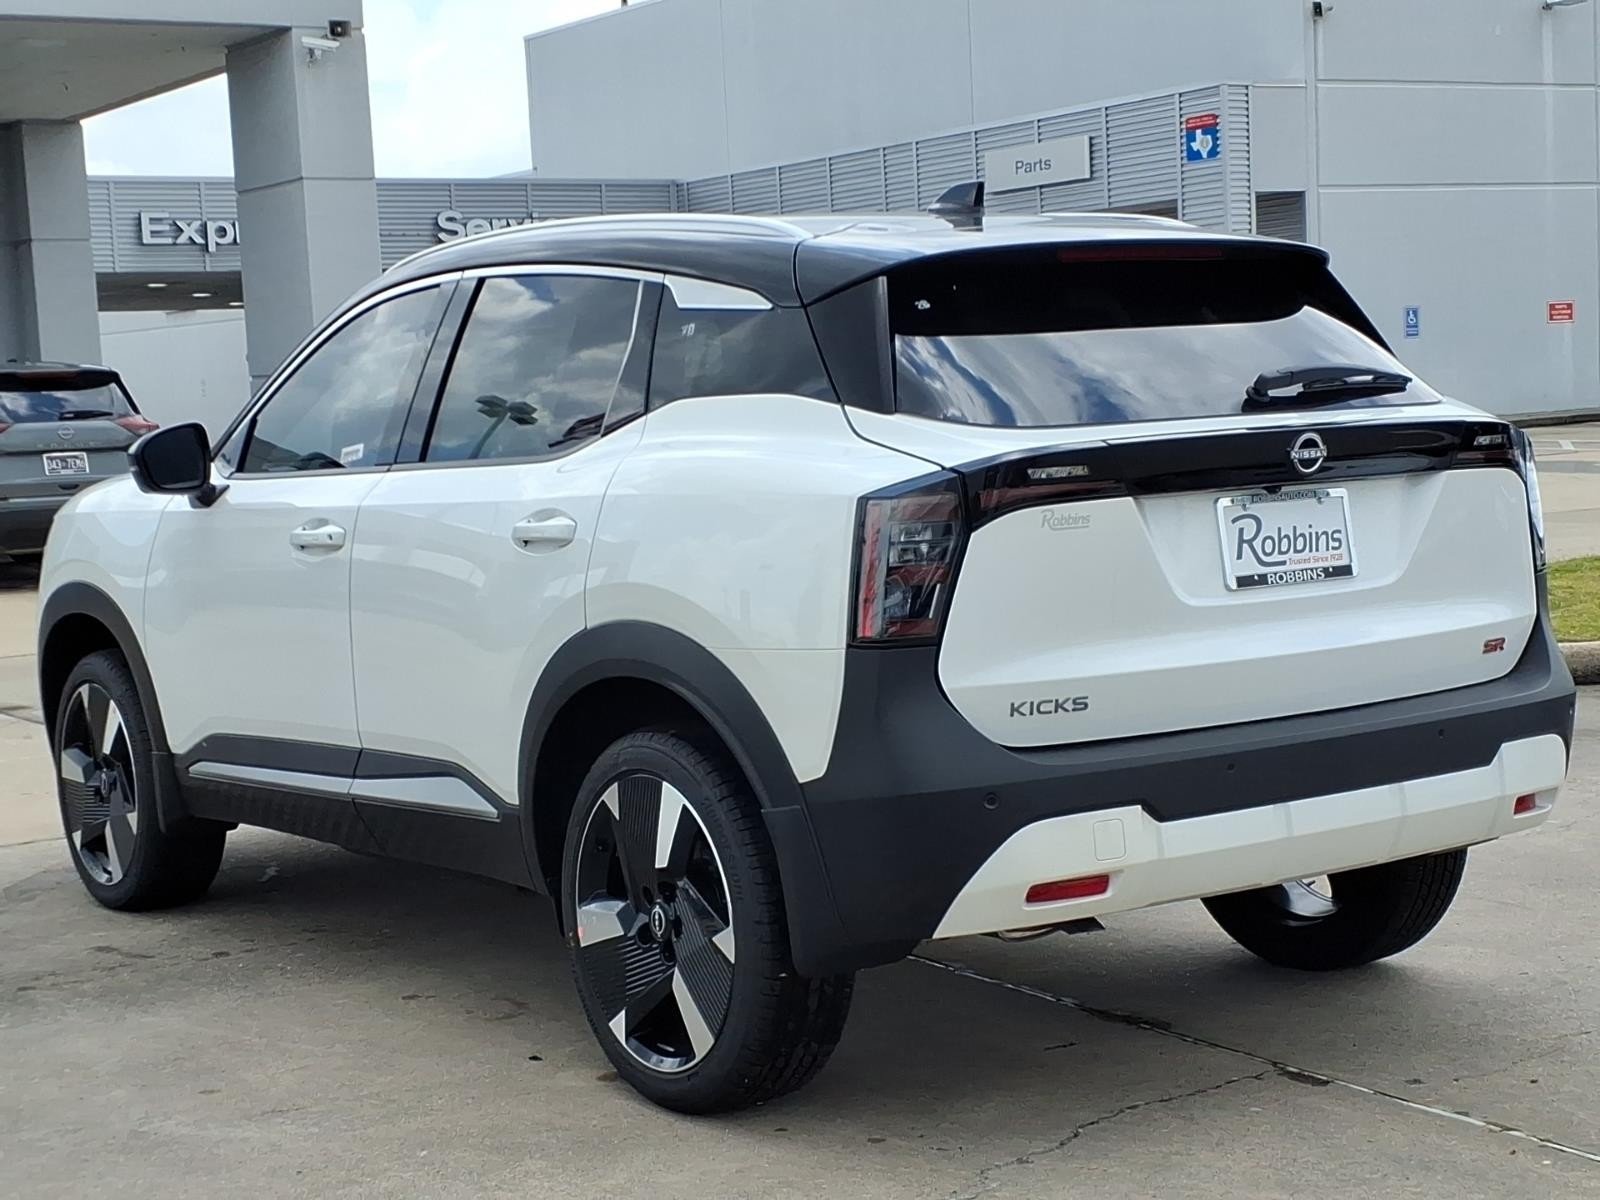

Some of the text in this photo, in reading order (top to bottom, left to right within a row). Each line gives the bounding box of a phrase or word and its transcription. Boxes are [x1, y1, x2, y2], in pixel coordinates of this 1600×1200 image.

[1015, 158, 1052, 175] Parts
[1290, 445, 1327, 459] NISSAN
[1040, 508, 1091, 531] Robbins
[1231, 513, 1342, 567] Robbins
[1267, 568, 1325, 585] ROBBINS
[1482, 637, 1506, 654] SR
[1009, 696, 1089, 717] KICKS
